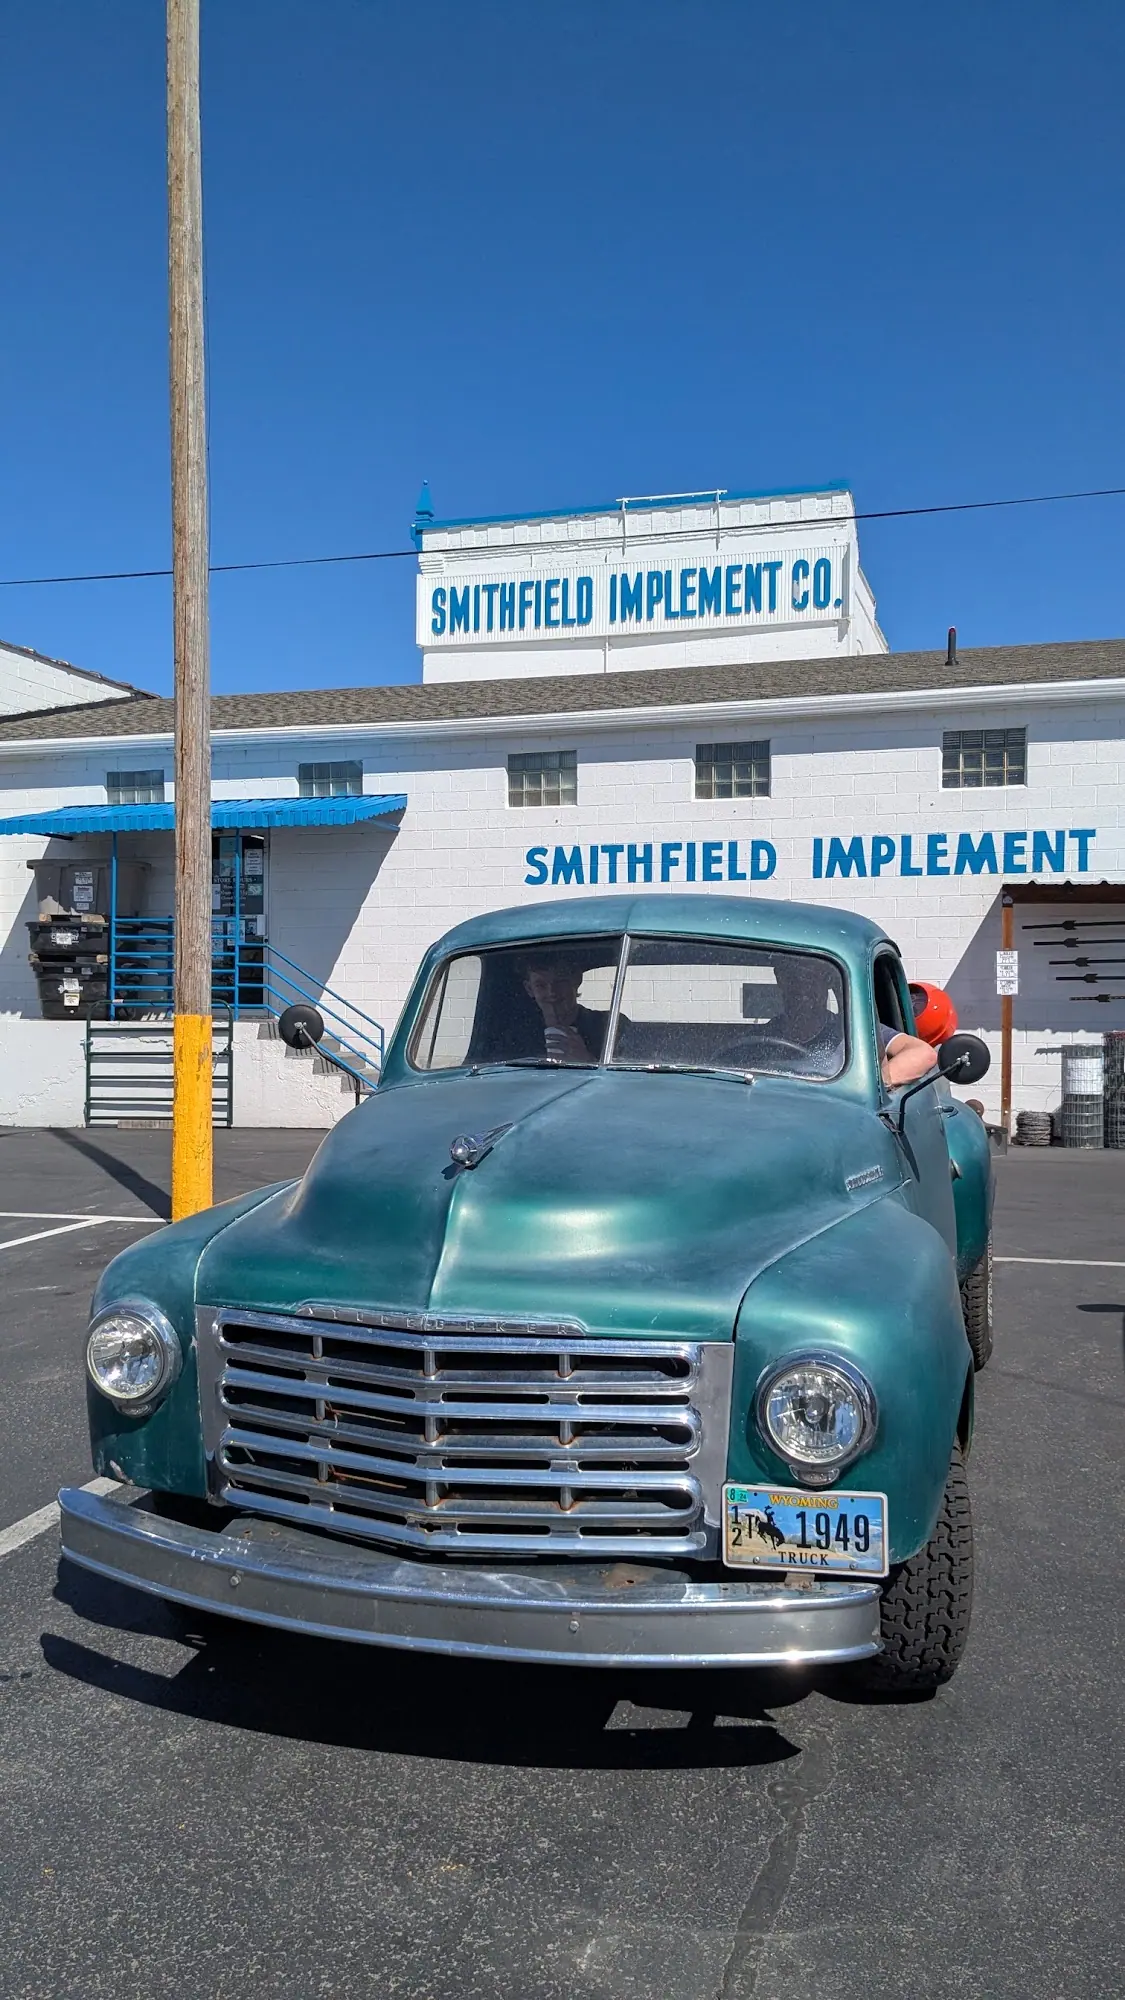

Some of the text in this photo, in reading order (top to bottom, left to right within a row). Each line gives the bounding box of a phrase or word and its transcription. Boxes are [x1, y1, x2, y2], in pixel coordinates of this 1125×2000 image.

[431, 557, 843, 635] SMITHFIELD IMPLEMENT CO.
[524, 828, 1096, 886] SMITHFIELD IMPLEMENT
[730, 1488, 736, 1501] 8
[768, 1494, 839, 1509] WYOMING
[796, 1511, 870, 1553] 1949
[778, 1551, 829, 1566] TRUCK
